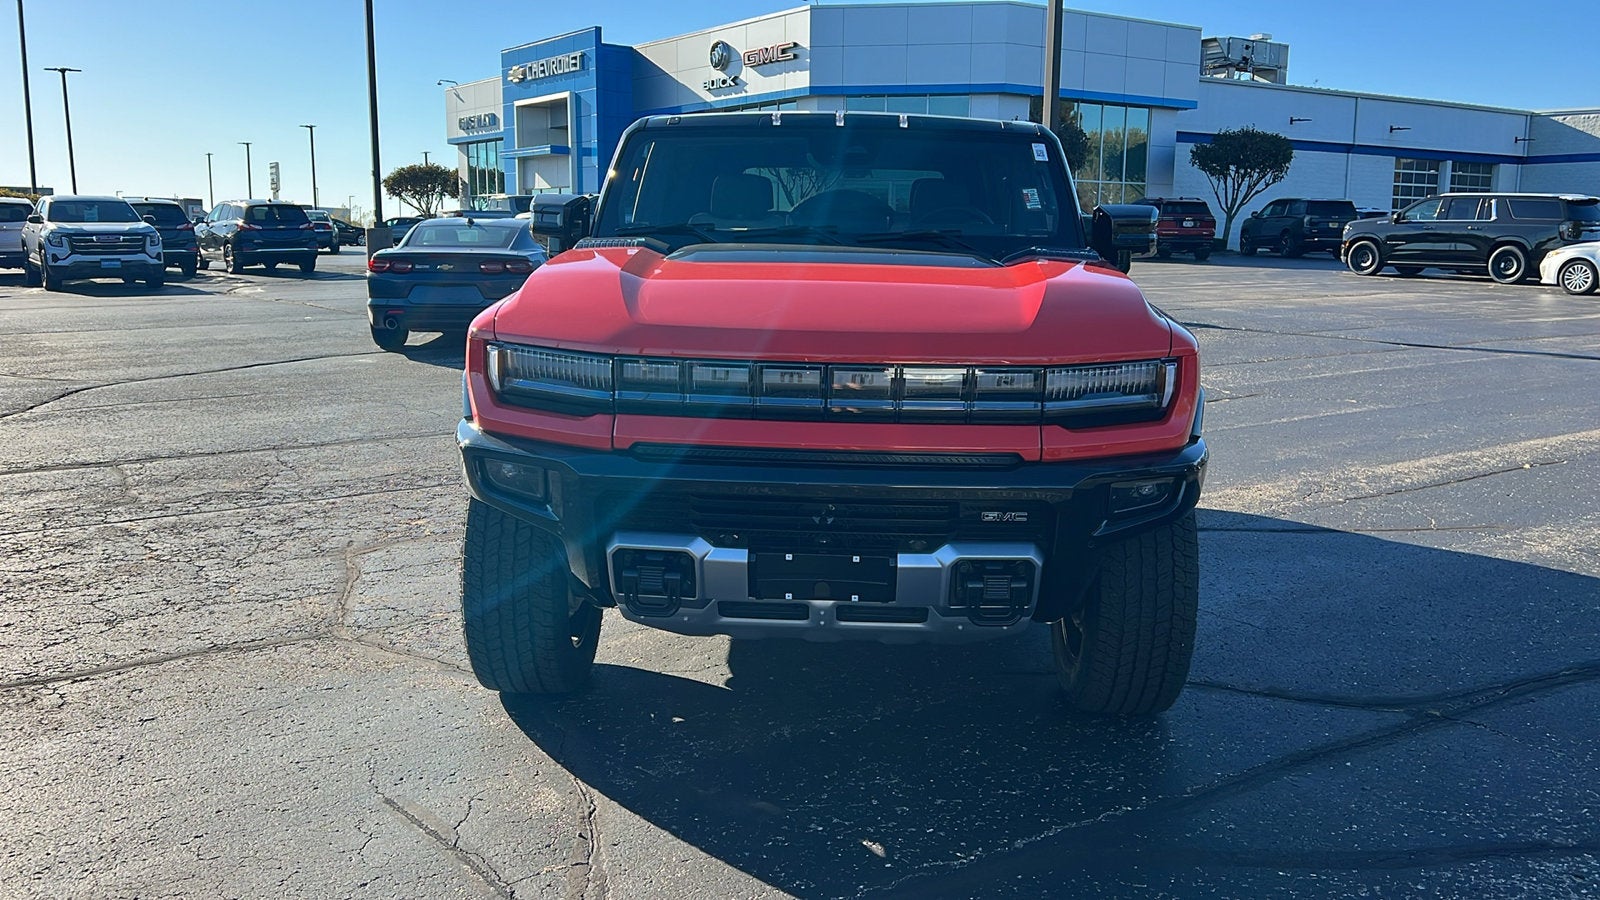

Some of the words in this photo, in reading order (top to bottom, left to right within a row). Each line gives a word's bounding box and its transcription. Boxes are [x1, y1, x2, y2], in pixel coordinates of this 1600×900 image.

[743, 42, 795, 67] GMC
[526, 51, 582, 80] CHEVROLET
[703, 76, 736, 91] BUICK
[981, 511, 1028, 522] GMC
